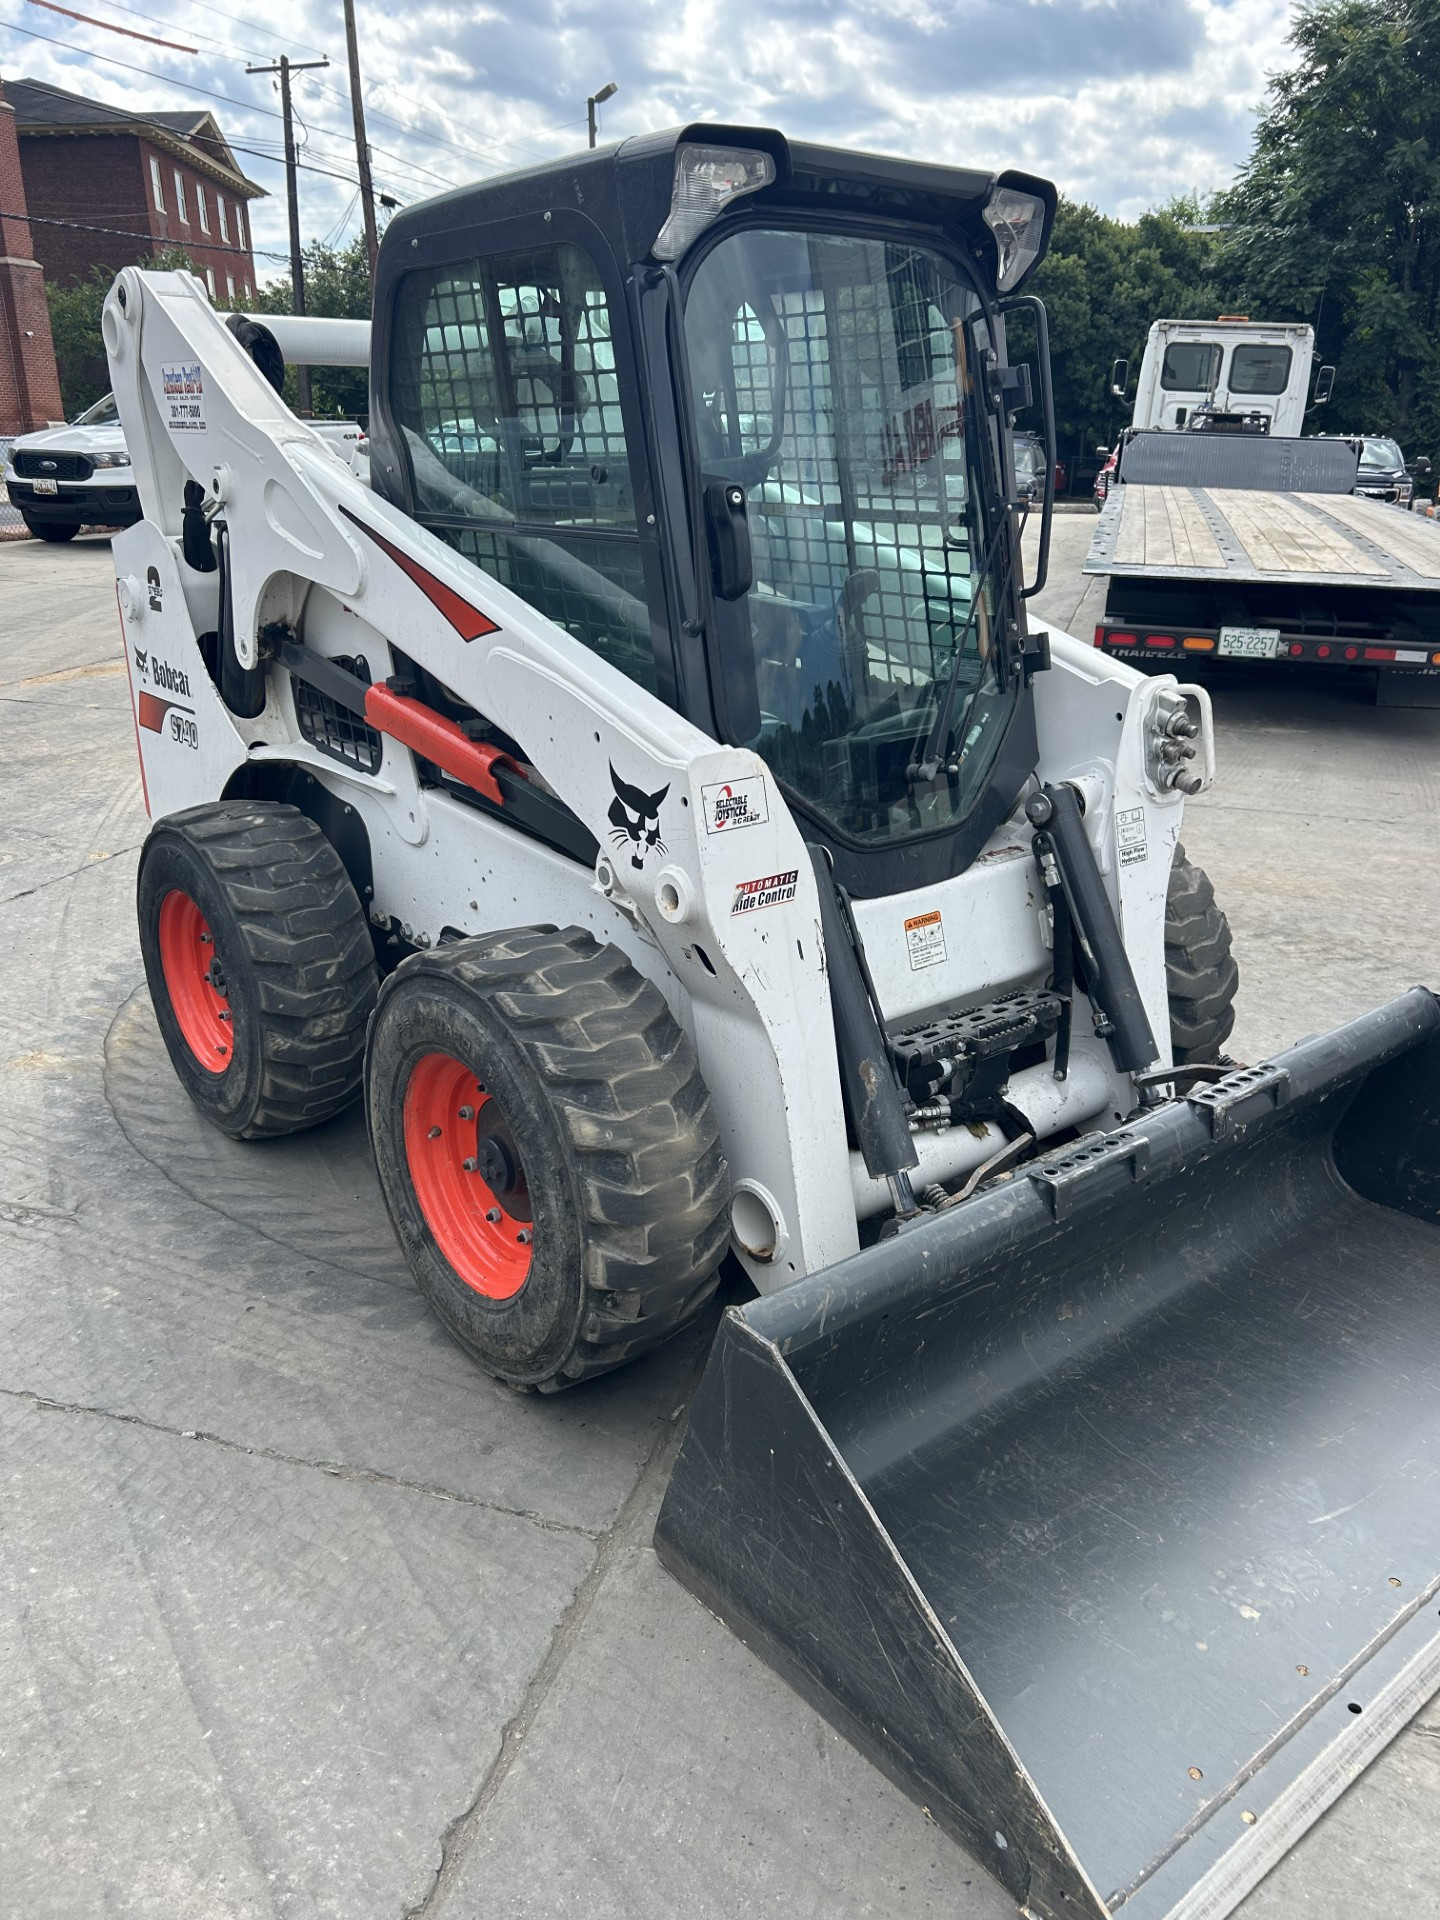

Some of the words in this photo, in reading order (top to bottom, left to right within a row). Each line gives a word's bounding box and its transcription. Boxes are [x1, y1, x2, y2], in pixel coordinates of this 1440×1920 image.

[151, 656, 190, 698] Bobcat
[170, 714, 198, 750] S740
[716, 795, 748, 809] SELECTABLE
[715, 804, 748, 822] JOYSTICKS
[758, 884, 797, 906] Control
[914, 914, 938, 926] WARNING
